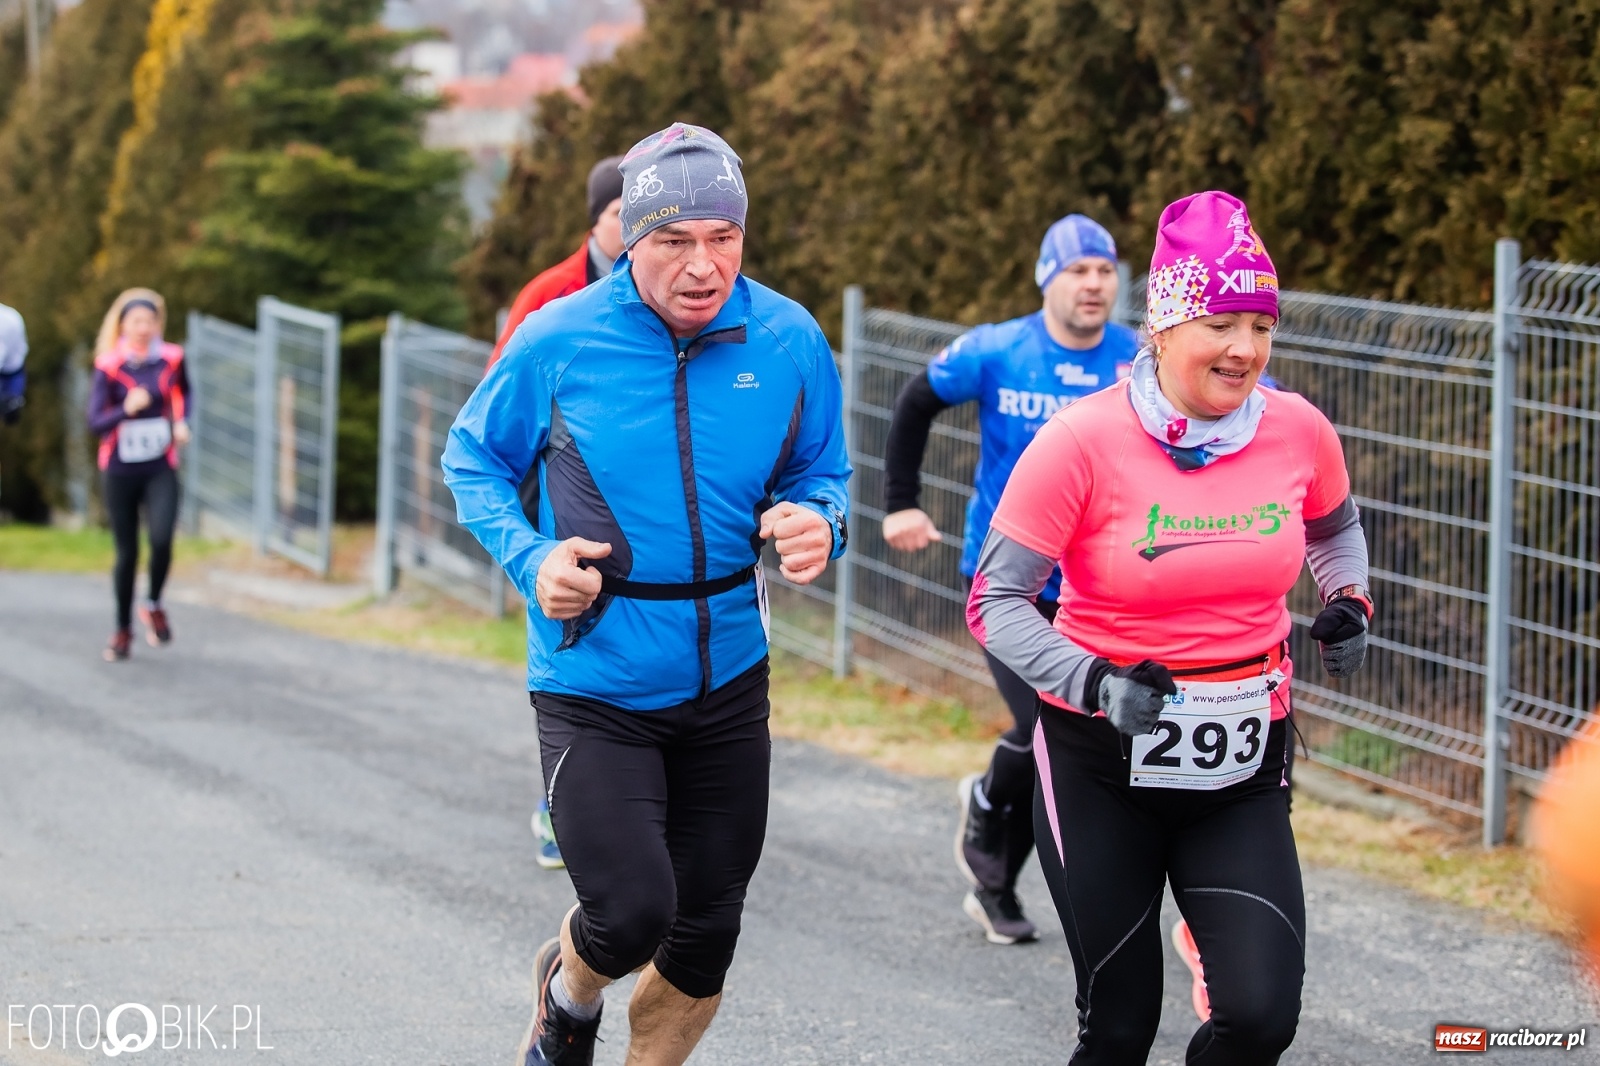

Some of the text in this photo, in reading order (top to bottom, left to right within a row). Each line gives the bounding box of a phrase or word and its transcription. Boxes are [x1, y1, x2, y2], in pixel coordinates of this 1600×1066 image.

[631, 204, 680, 235] DUATHLON
[1217, 269, 1256, 295] XIII
[733, 381, 760, 389] Kalenji
[1162, 502, 1291, 536] Kobiety na 5+
[1192, 687, 1267, 705] www.personalbest.pl
[1141, 716, 1262, 770] 293
